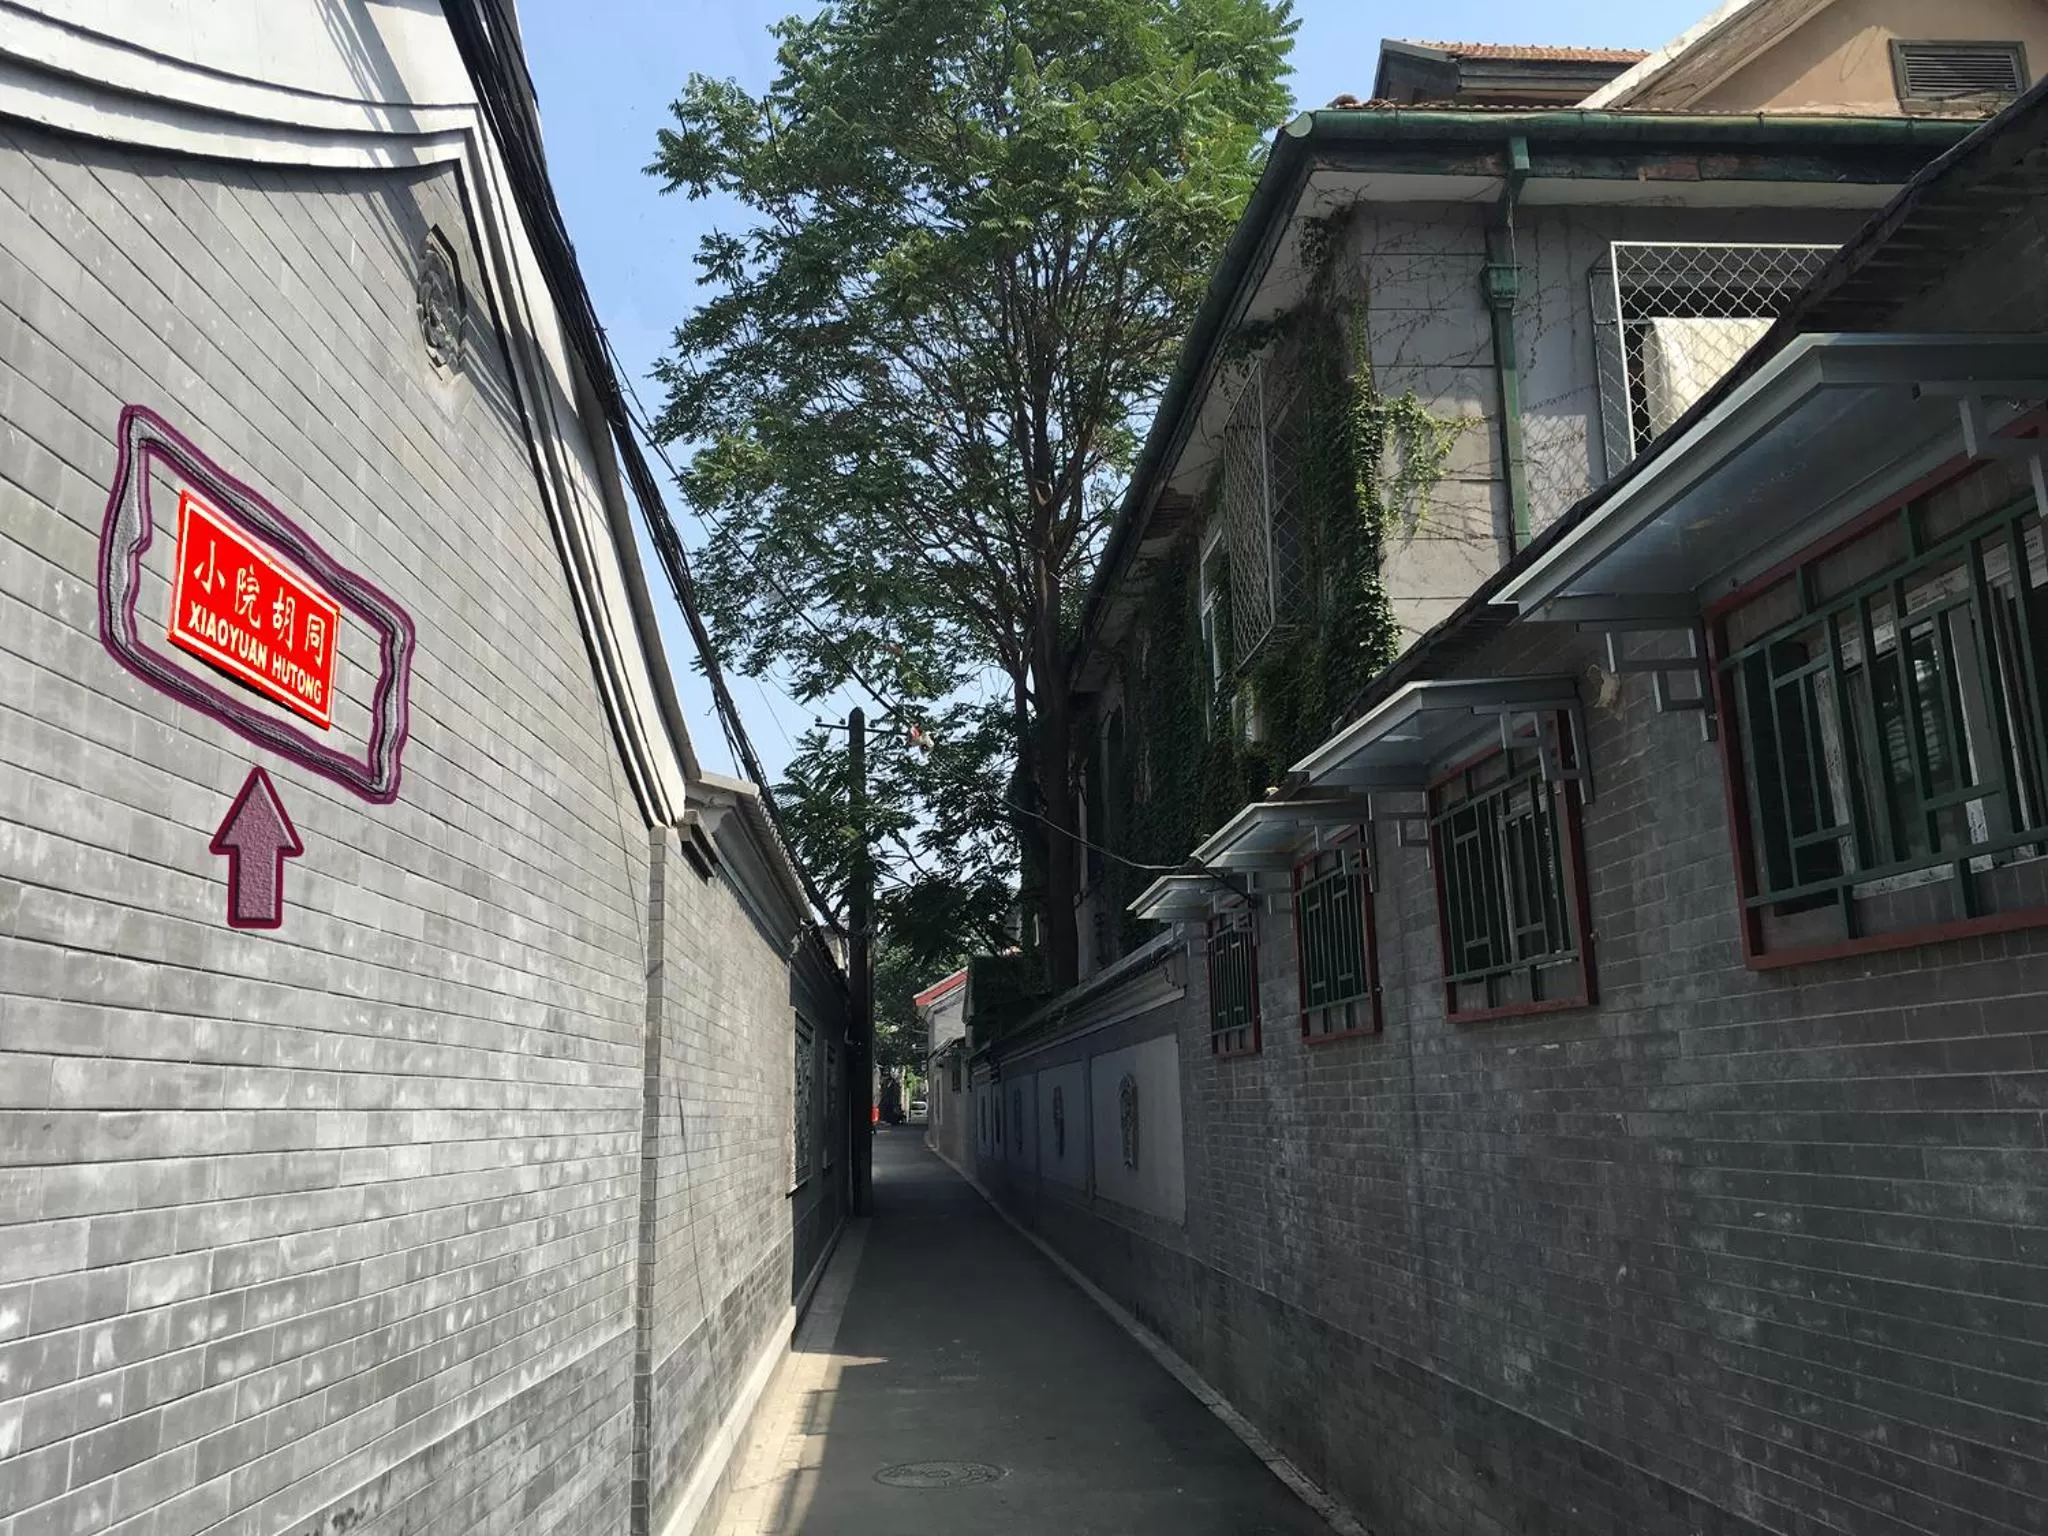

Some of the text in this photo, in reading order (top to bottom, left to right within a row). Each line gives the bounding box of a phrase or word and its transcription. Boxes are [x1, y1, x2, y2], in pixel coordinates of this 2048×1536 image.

[188, 600, 323, 705] XIAOYUAN HUTONG
[193, 539, 326, 669] 小院胡同
